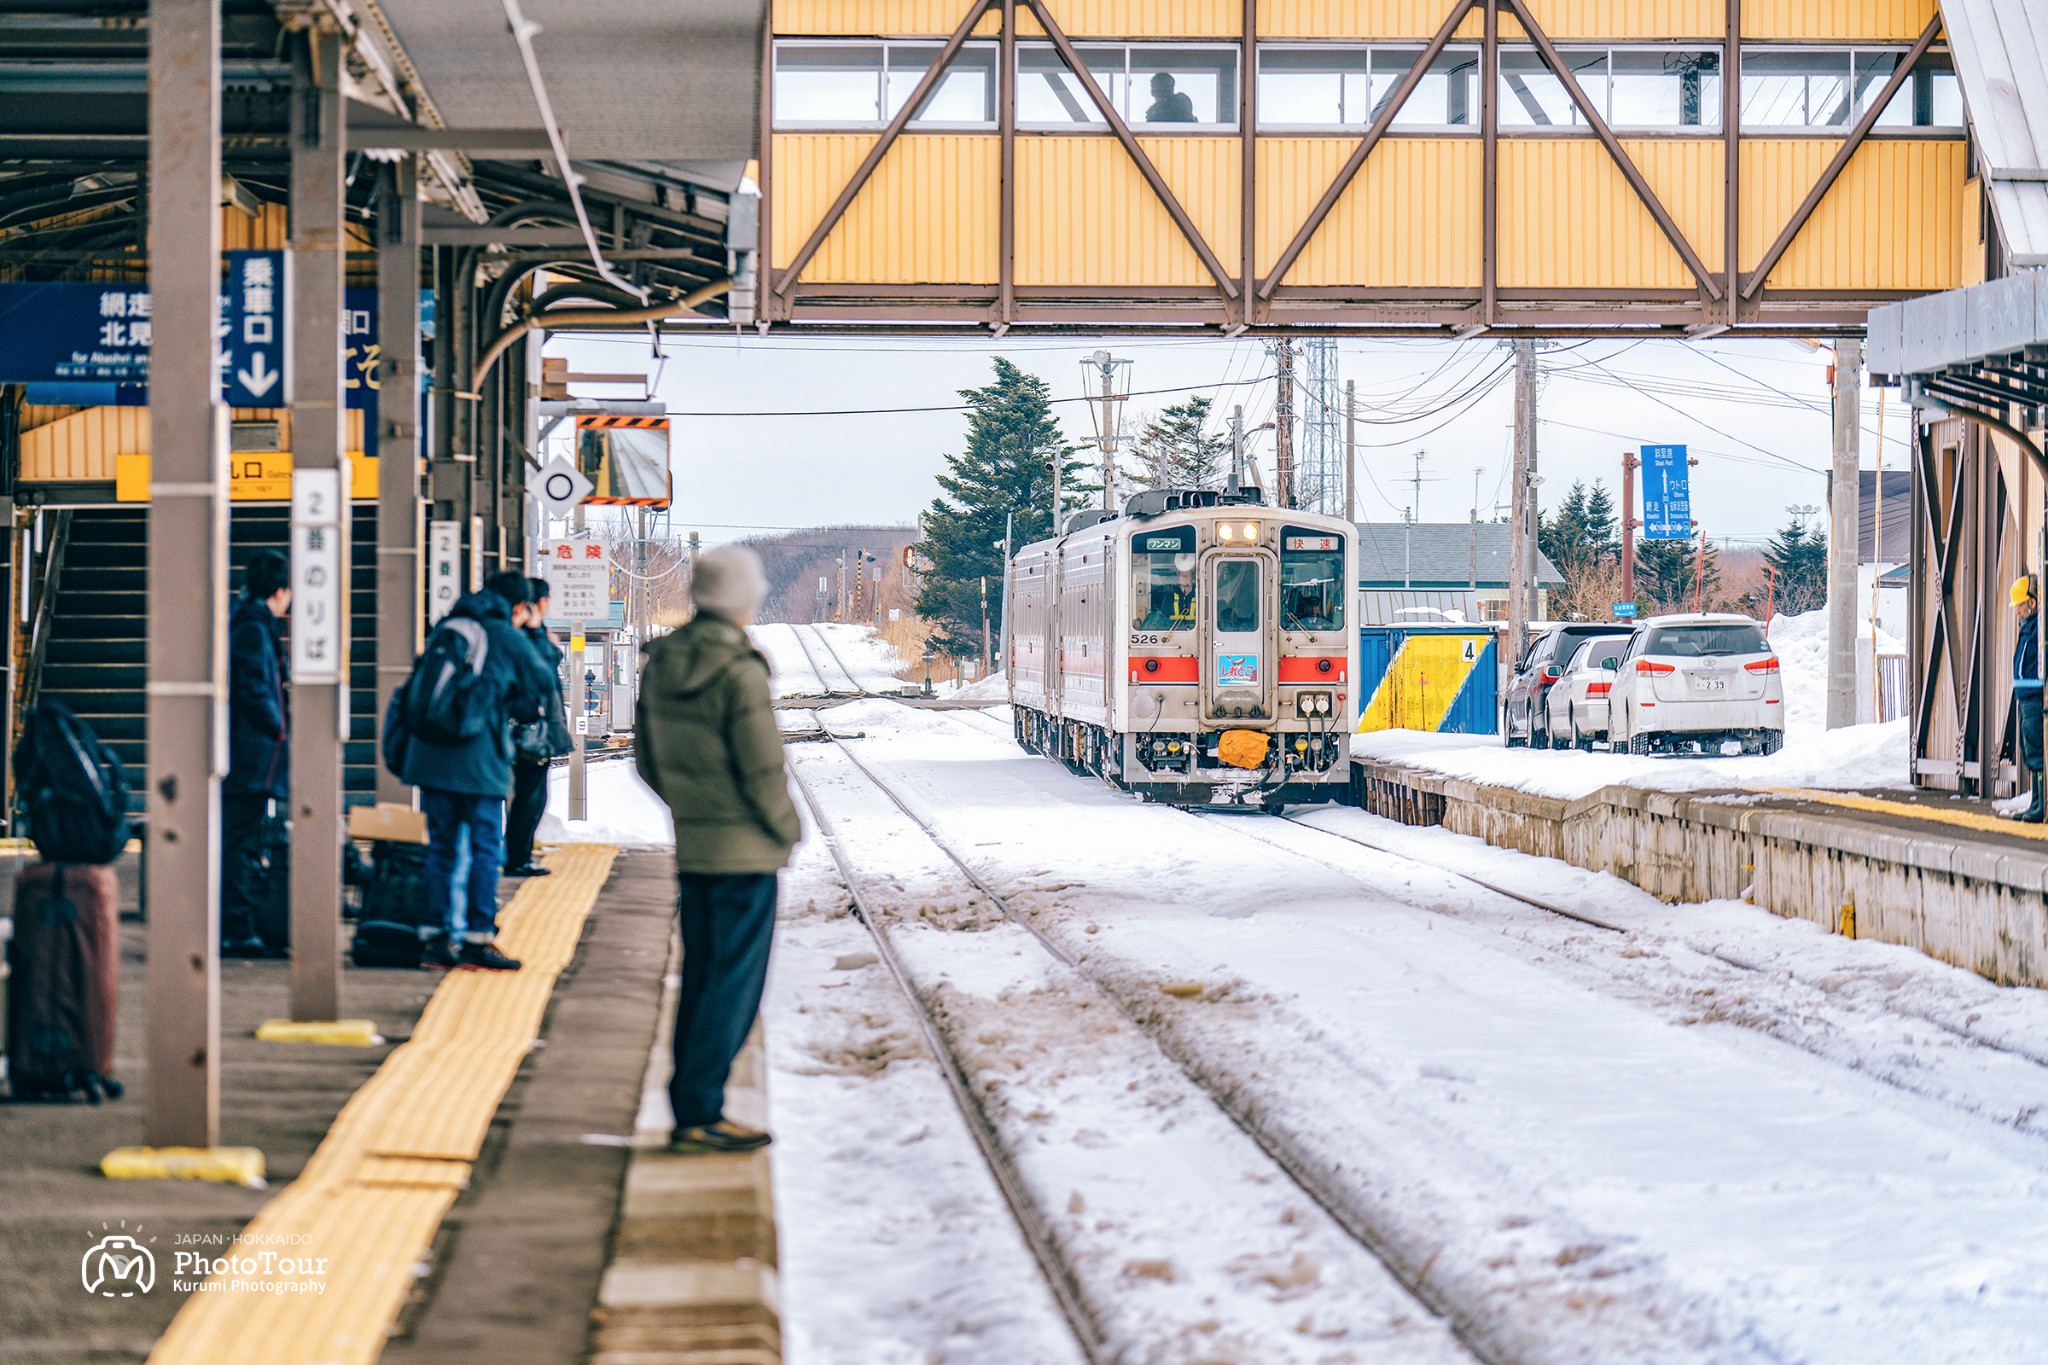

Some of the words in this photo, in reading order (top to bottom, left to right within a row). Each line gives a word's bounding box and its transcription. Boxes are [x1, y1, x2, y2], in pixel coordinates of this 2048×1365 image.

[1292, 538, 1332, 550] 快速
[556, 544, 602, 559] 危険
[303, 491, 328, 660] 2番のりば
[1131, 634, 1158, 644] 526
[1464, 641, 1475, 660] 4
[1221, 665, 1254, 677] しれとこ
